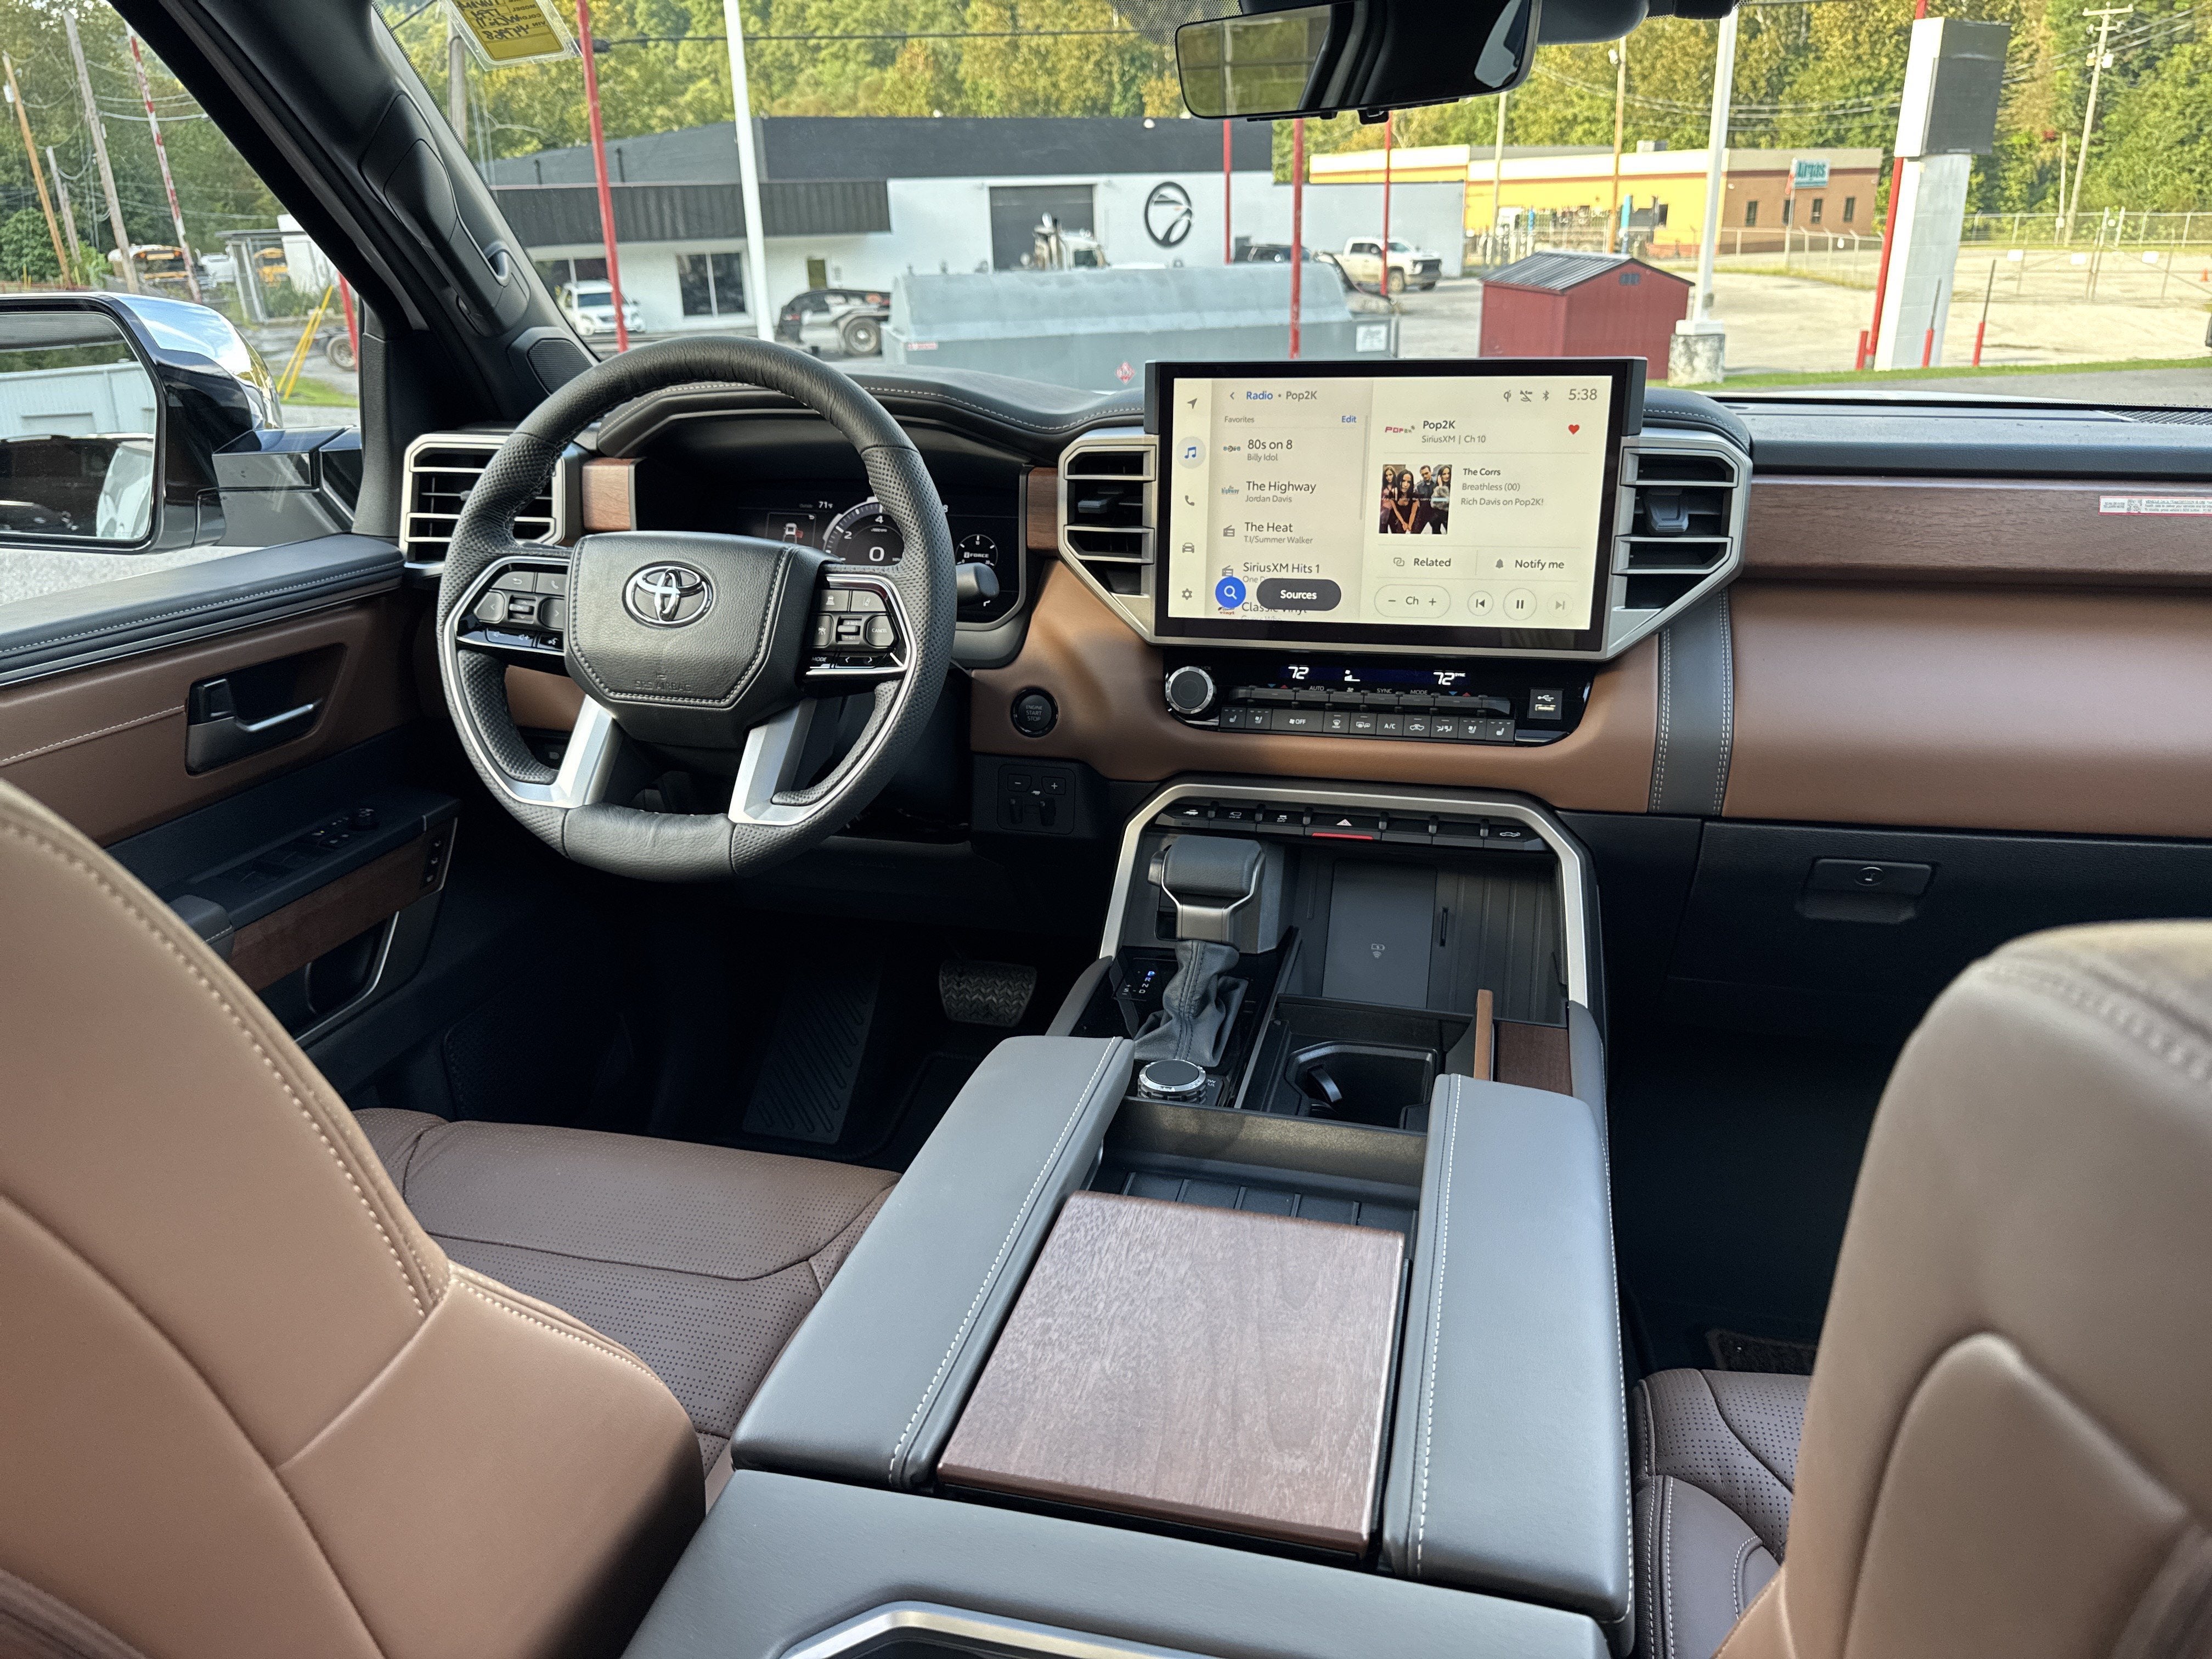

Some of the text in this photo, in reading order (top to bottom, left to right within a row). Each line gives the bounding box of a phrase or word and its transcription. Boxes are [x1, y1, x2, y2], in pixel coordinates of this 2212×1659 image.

[1246, 391, 1317, 402] Radio Pop2K
[1568, 388, 1598, 400] 5:38
[1423, 421, 1455, 431] Pop2K
[1421, 435, 1456, 443] SiriusXM
[1464, 435, 1475, 443] Ch
[1248, 439, 1266, 450] 80s
[1285, 440, 1293, 450] 8
[1247, 453, 1263, 462] Billy
[1246, 482, 1316, 494] The Highway
[1462, 483, 1520, 492] Breathless (00)
[1272, 495, 1292, 503] Davis
[1460, 498, 1477, 506] Rich
[1479, 498, 1501, 506] Davis
[1515, 498, 1544, 507] Pop2K!
[1245, 522, 1293, 532] The Heat
[844, 531, 852, 539] 2
[869, 546, 885, 562] 0
[1414, 557, 1451, 567] Related
[1515, 560, 1546, 570] Notify
[1243, 562, 1320, 574] SiriusXM Hits 1
[1280, 590, 1317, 600] Sources
[1406, 596, 1419, 605] Ch
[1288, 665, 1310, 680] 72
[1433, 671, 1455, 686] 72
